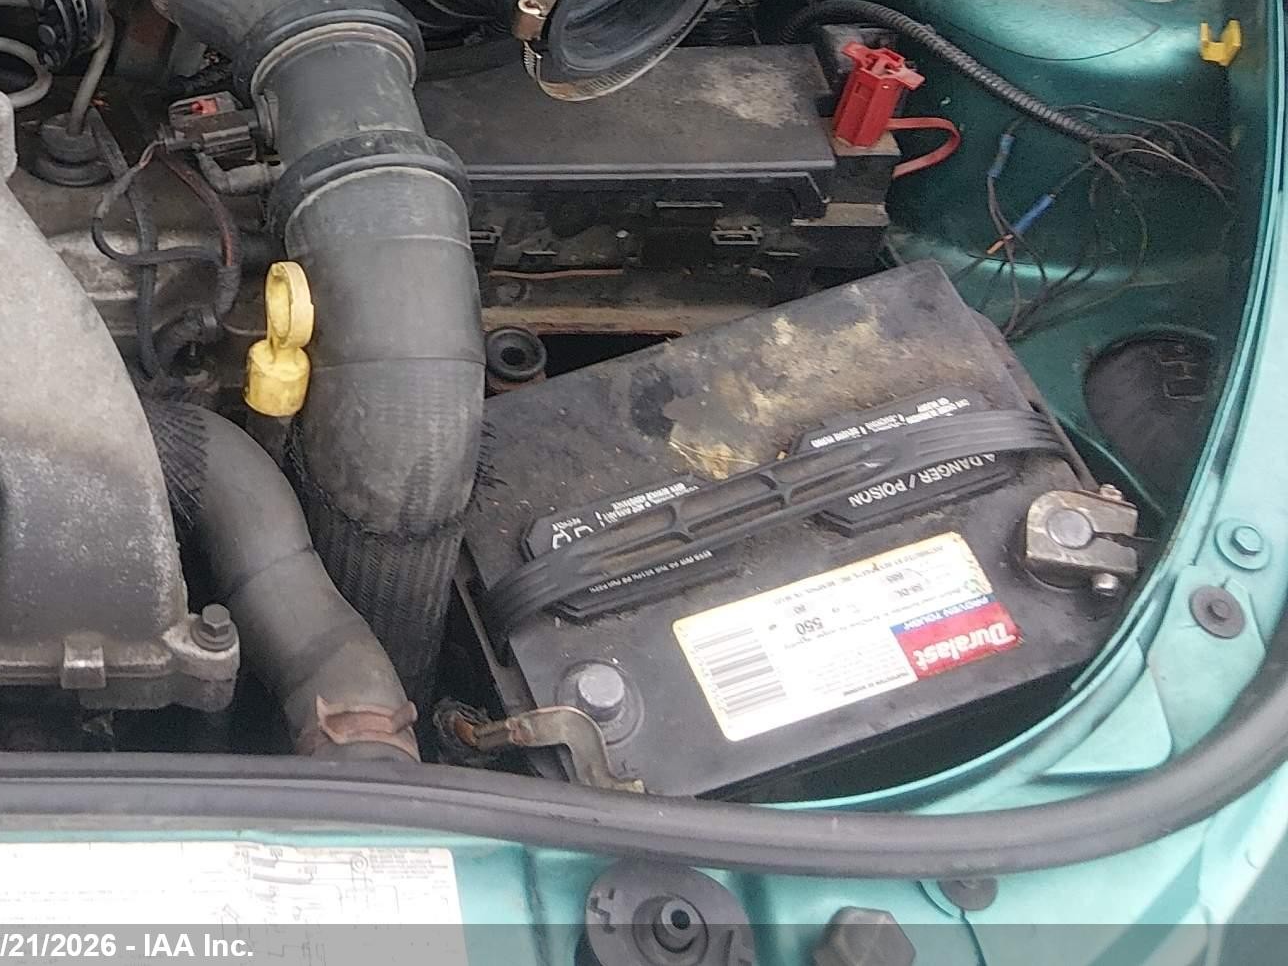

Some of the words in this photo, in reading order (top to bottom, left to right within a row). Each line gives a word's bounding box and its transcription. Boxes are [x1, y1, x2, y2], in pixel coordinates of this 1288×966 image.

[918, 455, 984, 484] DANGER
[848, 479, 907, 507] POISON
[795, 617, 824, 636] 550
[912, 622, 1017, 671] Duralast
